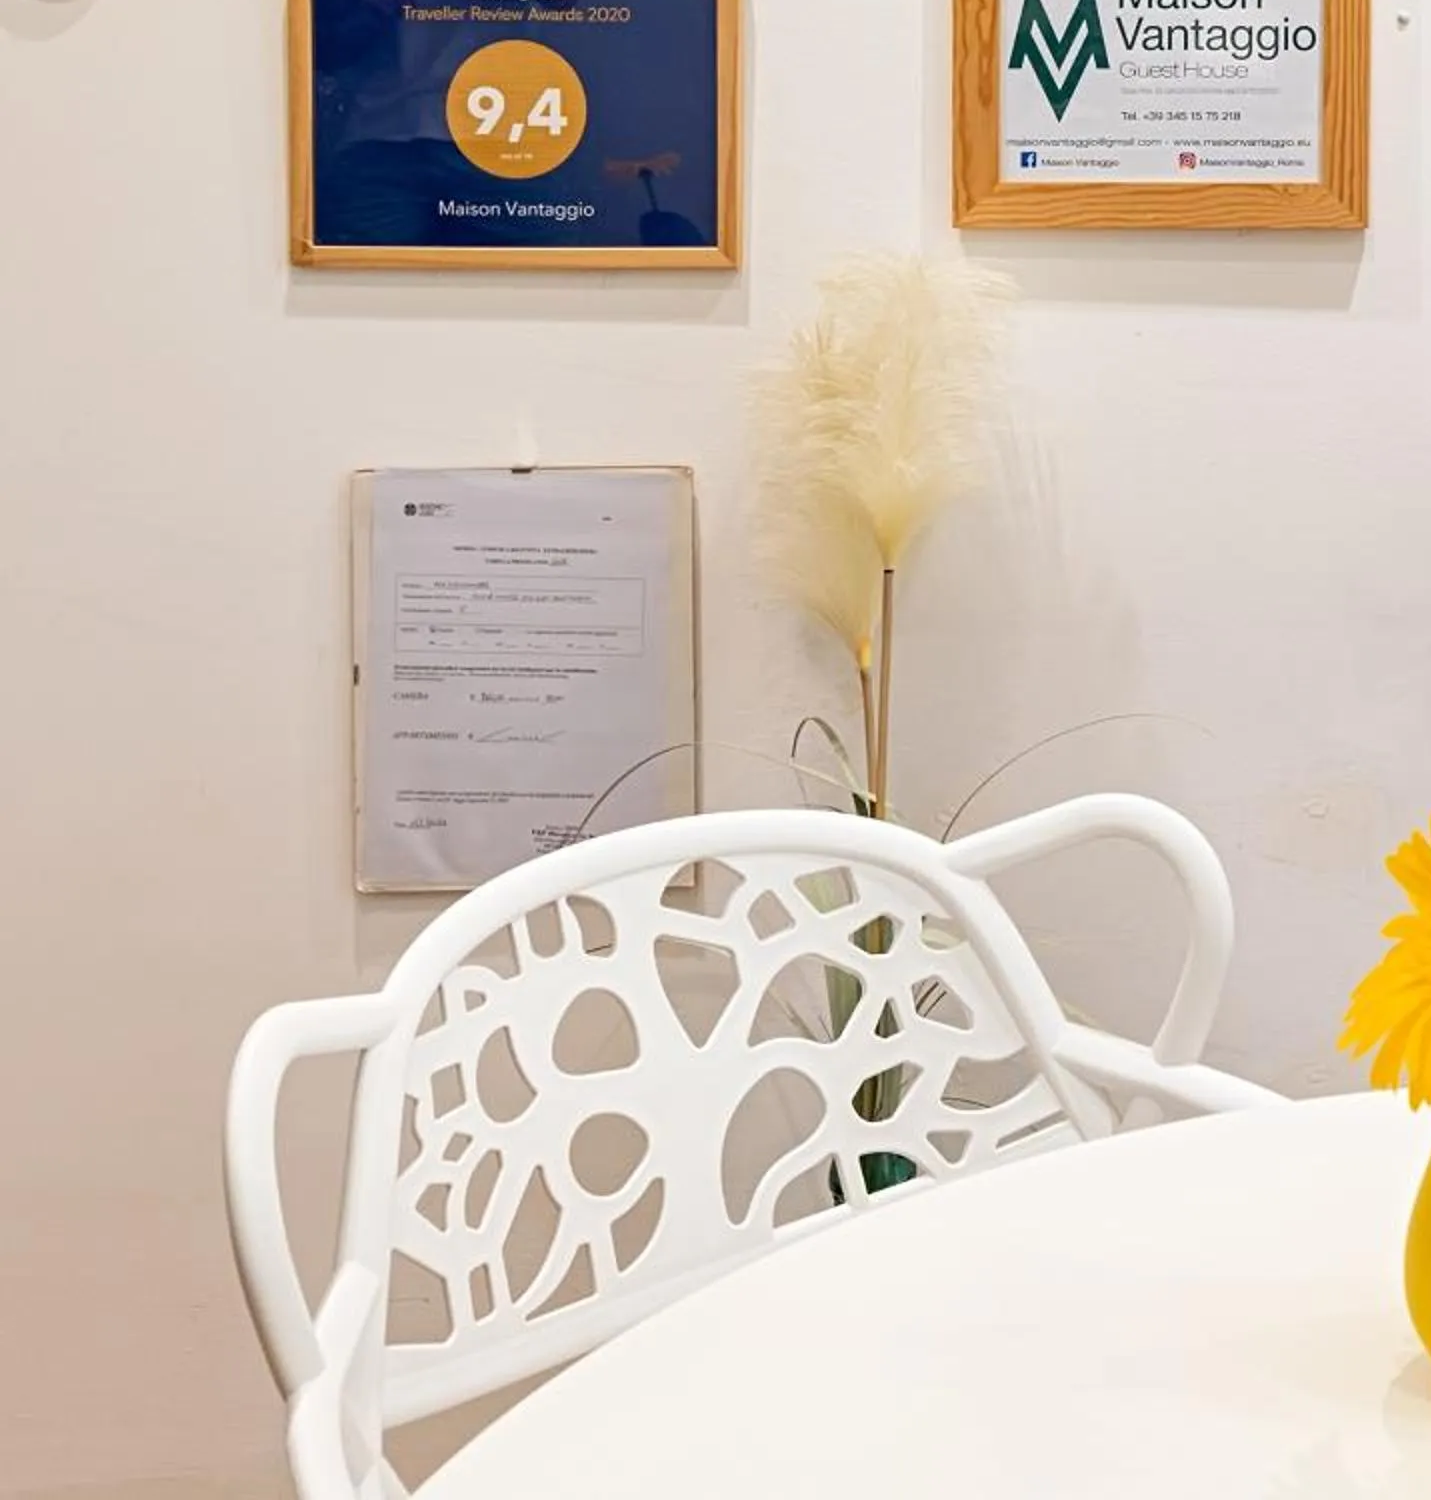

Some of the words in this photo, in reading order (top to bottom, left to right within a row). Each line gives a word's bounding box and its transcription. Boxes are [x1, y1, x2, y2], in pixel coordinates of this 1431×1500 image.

[402, 6, 465, 21] Traveller
[471, 6, 523, 21] Review
[528, 7, 584, 22] Awards
[587, 7, 631, 22] 2020
[1116, 16, 1317, 61] Vantaggio
[467, 86, 567, 143] 9,4
[438, 201, 501, 217] Maison
[505, 201, 595, 221] Vantaggio
